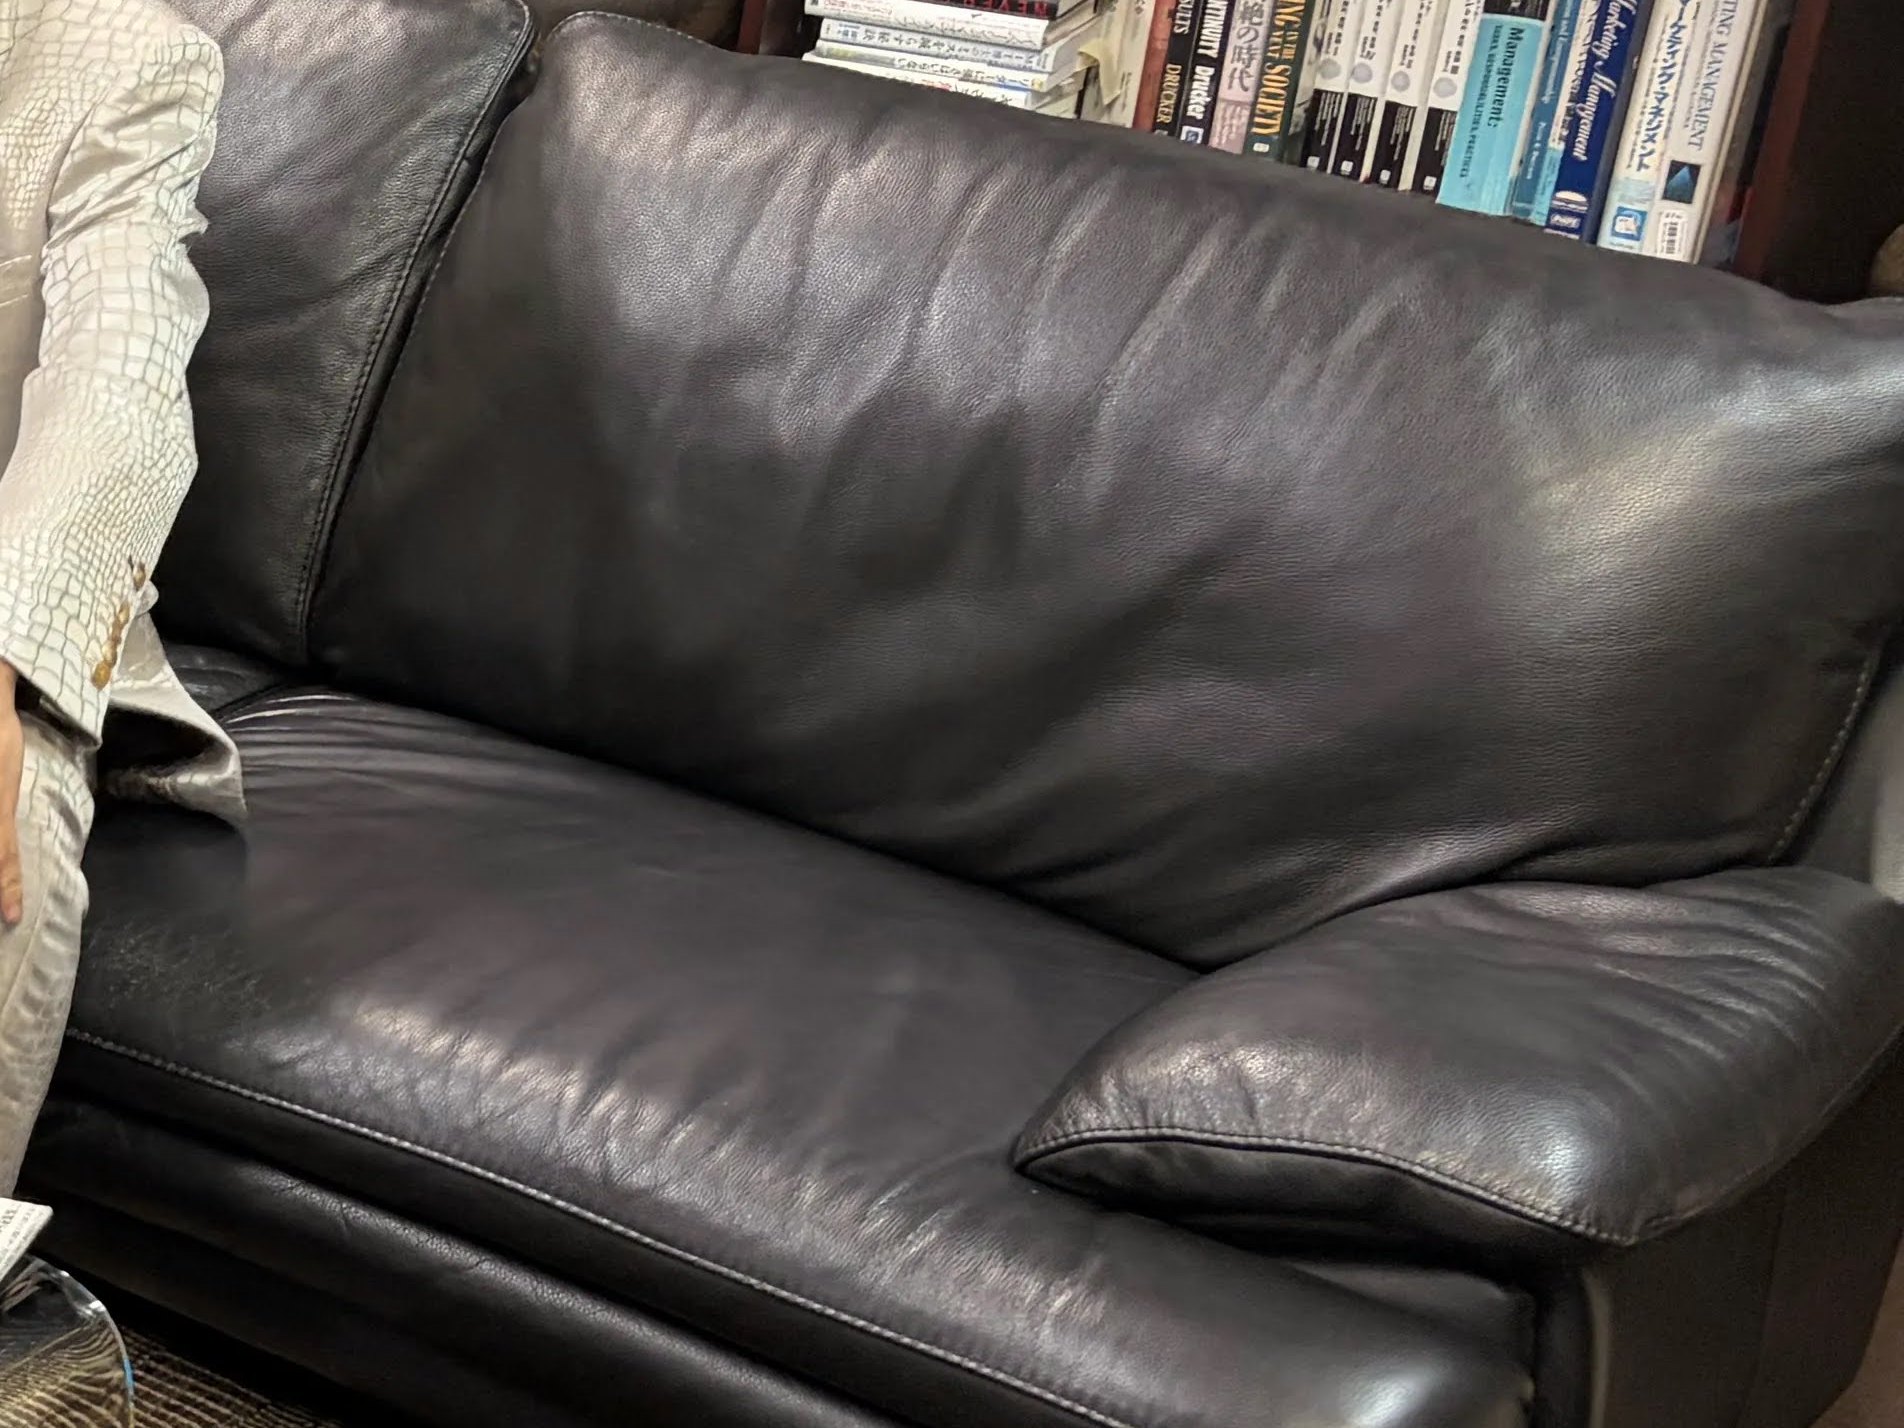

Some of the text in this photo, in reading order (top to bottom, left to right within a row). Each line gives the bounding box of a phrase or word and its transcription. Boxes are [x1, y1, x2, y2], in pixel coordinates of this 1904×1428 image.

[1156, 65, 1183, 123] DRUCKER
[1188, 66, 1214, 120] Drucker
[1252, 63, 1291, 136] SOCIETY
[1572, 60, 1619, 160] Management
[1688, 41, 1729, 151] MANAGEMENT
